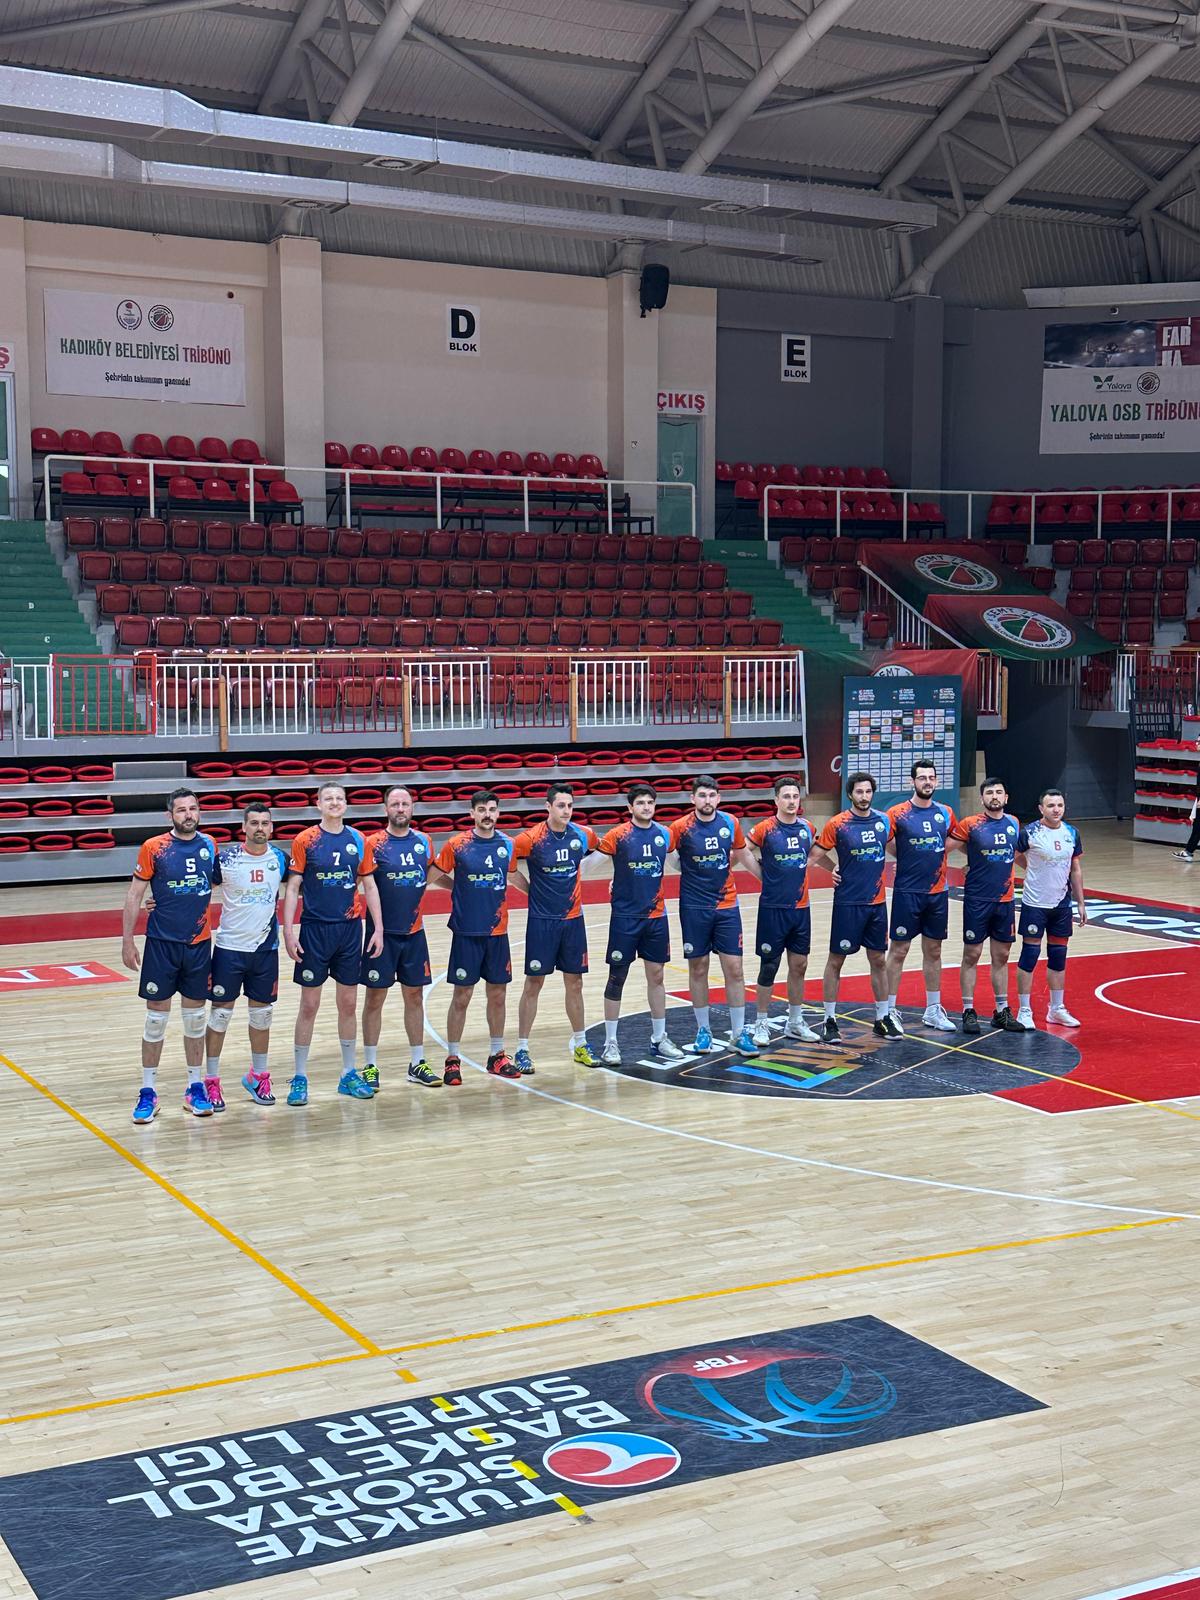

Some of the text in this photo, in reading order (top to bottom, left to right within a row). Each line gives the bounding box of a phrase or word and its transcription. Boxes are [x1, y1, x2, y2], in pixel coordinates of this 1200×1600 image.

[450, 308, 476, 339] D
[60, 337, 231, 365] KADIKÖY BELEDİYESİ TRİBÜNÜ
[449, 342, 477, 352] BLOK
[787, 339, 806, 367] E
[783, 369, 808, 379] BLOK
[1107, 382, 1132, 390] Yalova
[657, 392, 705, 413] ÇIKIŞ
[1051, 403, 1108, 422] YALOVA
[1113, 403, 1141, 421] OSB
[923, 821, 932, 832] 9
[704, 837, 719, 849] 23
[786, 837, 799, 849] 12
[861, 831, 876, 843] 22
[994, 834, 1006, 845] 13
[643, 844, 652, 857] 11
[1054, 841, 1061, 851] 6
[333, 852, 341, 865] 7
[400, 853, 415, 865] 14
[485, 855, 493, 868] 4
[556, 849, 569, 862] 10
[186, 858, 196, 873] 5
[250, 870, 264, 883] 16
[693, 1355, 748, 1372] TBF
[133, 1376, 591, 1487] SÜPER LİGİ
[106, 1400, 631, 1519] BASKETBOL
[205, 1454, 521, 1535] SİGORTA
[234, 1480, 562, 1566] TÜRKİYE
